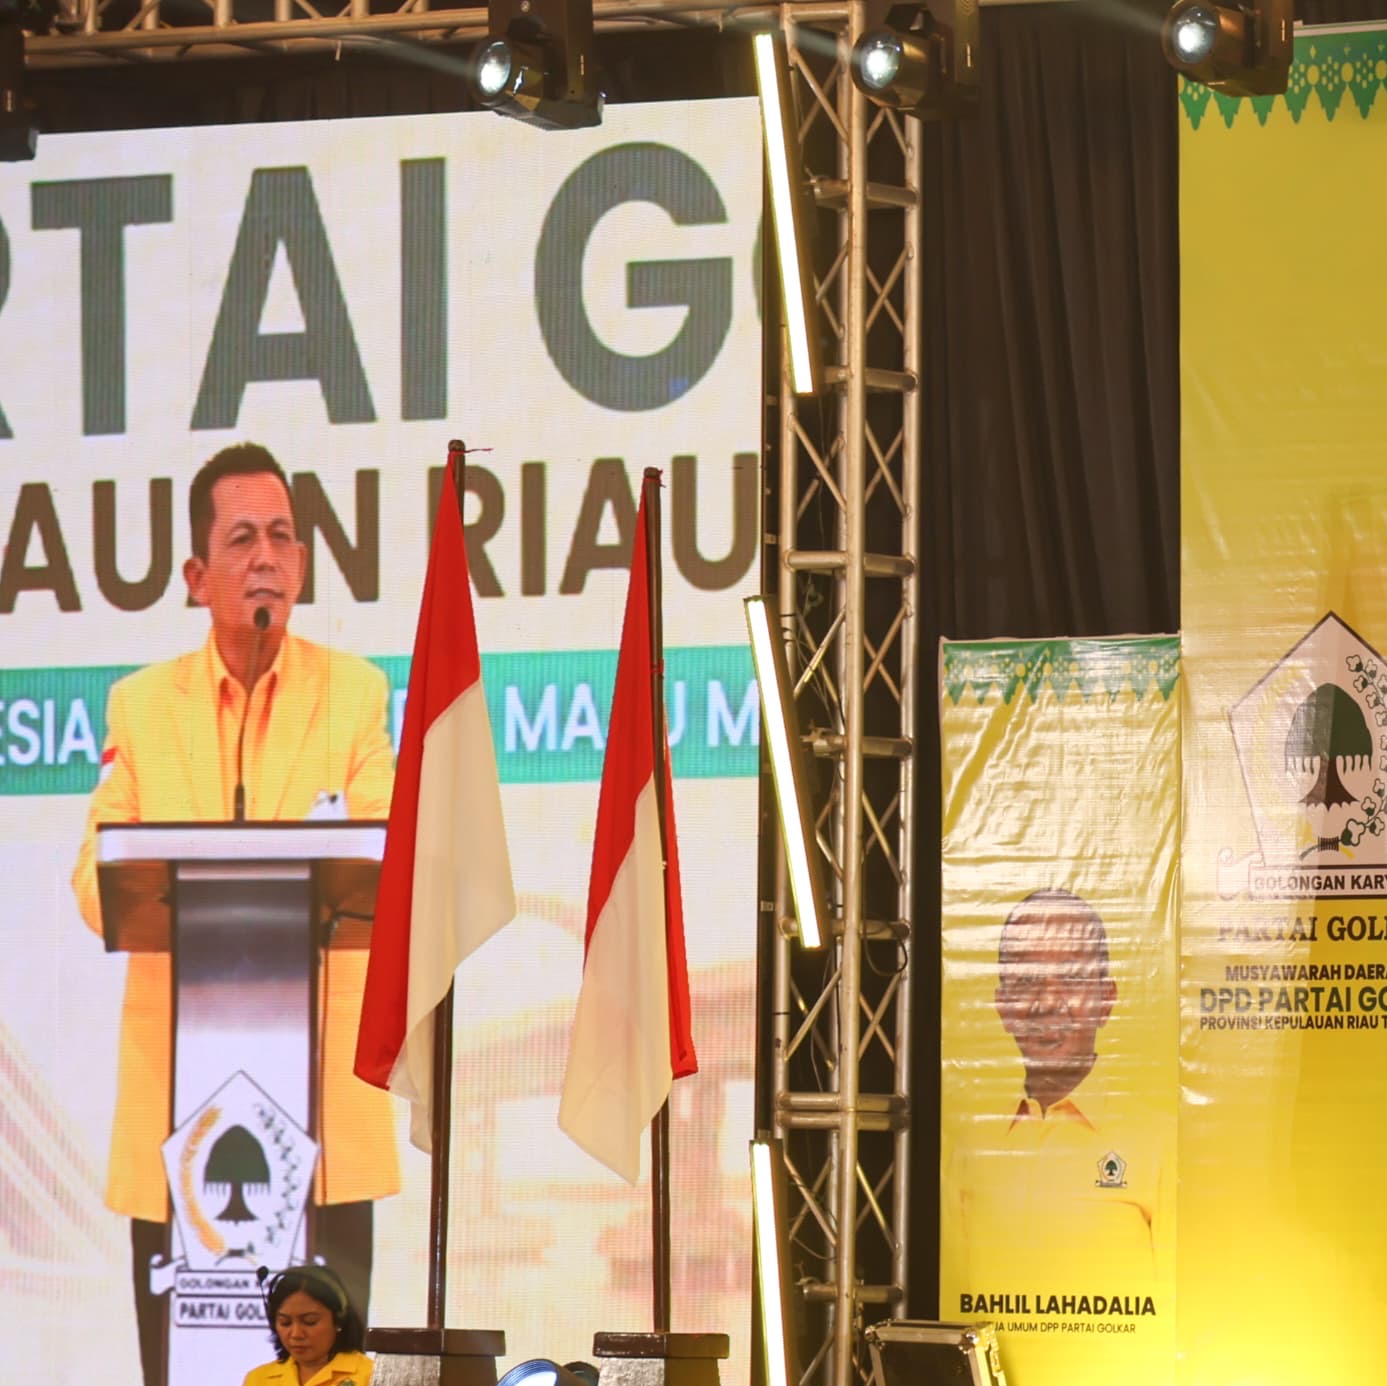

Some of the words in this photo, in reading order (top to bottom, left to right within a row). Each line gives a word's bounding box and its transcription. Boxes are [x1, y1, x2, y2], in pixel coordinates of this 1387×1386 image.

[0, 157, 448, 438] TAI
[534, 141, 763, 412] G
[0, 471, 380, 613] AUN
[0, 698, 99, 766] SIA
[1254, 875, 1345, 891] GOLONGAN
[1217, 916, 1317, 941] PARTAI
[1226, 964, 1341, 981] MUSYAWARAH
[1200, 988, 1251, 1013] DPD
[1259, 987, 1351, 1012] PARTAI
[1200, 1015, 1262, 1030] PROVINSI
[1266, 1015, 1344, 1030] KEPULAUAN
[1347, 1014, 1378, 1029] RIAU
[180, 1279, 249, 1289] GOLONGAN
[960, 1294, 1031, 1314] BAHLIL
[1036, 1295, 1156, 1316] LAHADALIA
[1007, 1322, 1038, 1333] UMUM
[1040, 1322, 1059, 1333] DPP
[1061, 1322, 1095, 1333] PARTAI
[1096, 1323, 1136, 1334] GOLKAR
